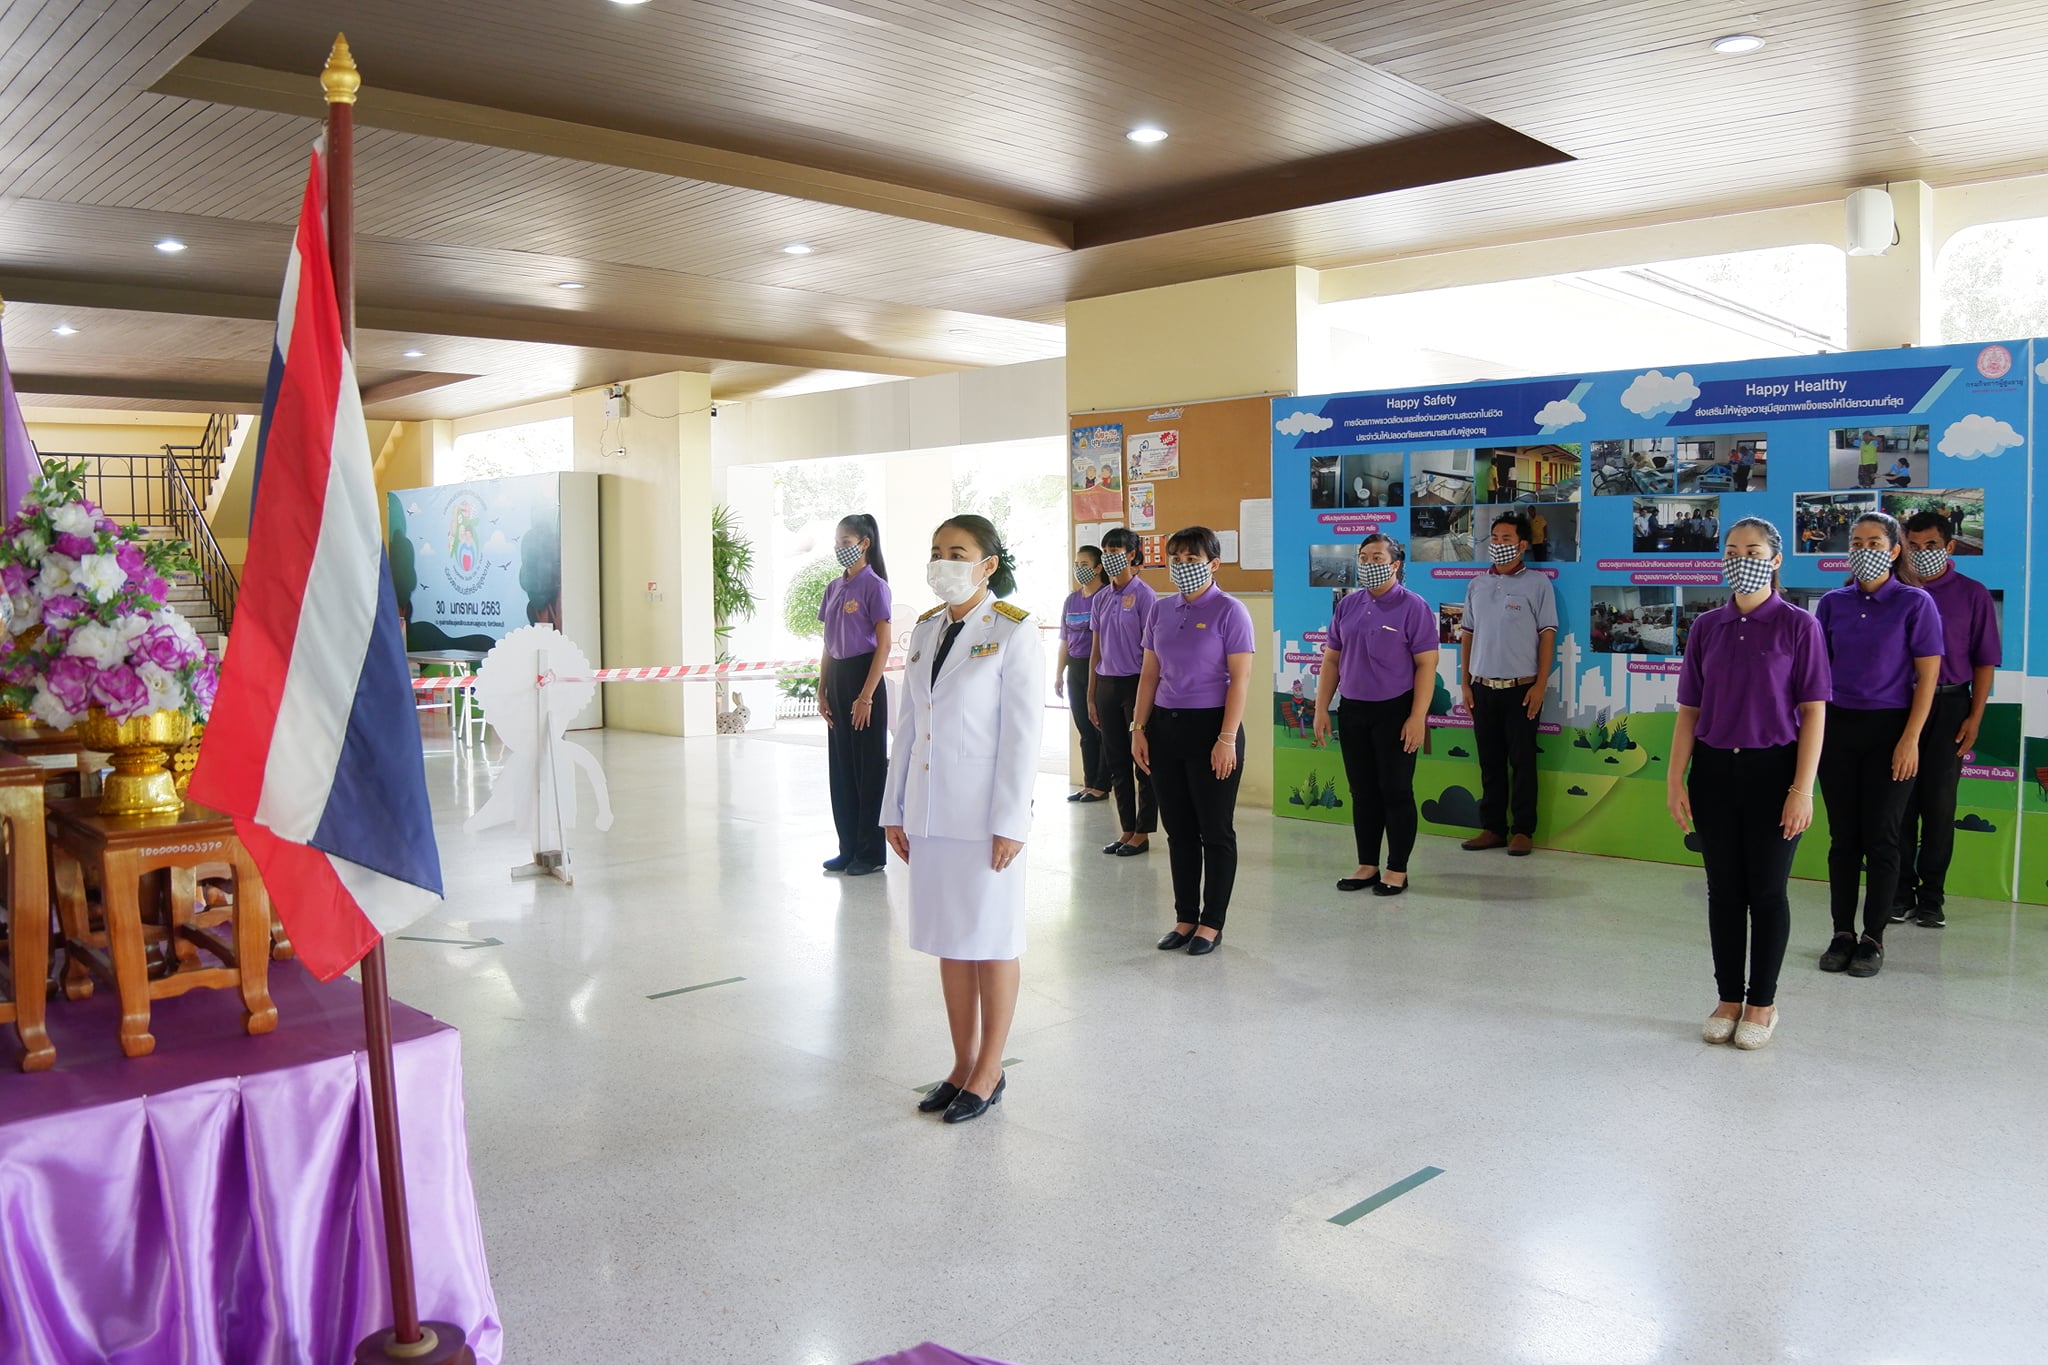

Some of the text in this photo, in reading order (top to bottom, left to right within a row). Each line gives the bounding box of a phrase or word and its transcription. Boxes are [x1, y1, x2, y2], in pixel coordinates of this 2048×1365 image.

[1746, 379, 1847, 397] Happy Healthy
[1386, 394, 1457, 410] Happy Safety
[435, 600, 501, 615] 30 มกราคม 2563
